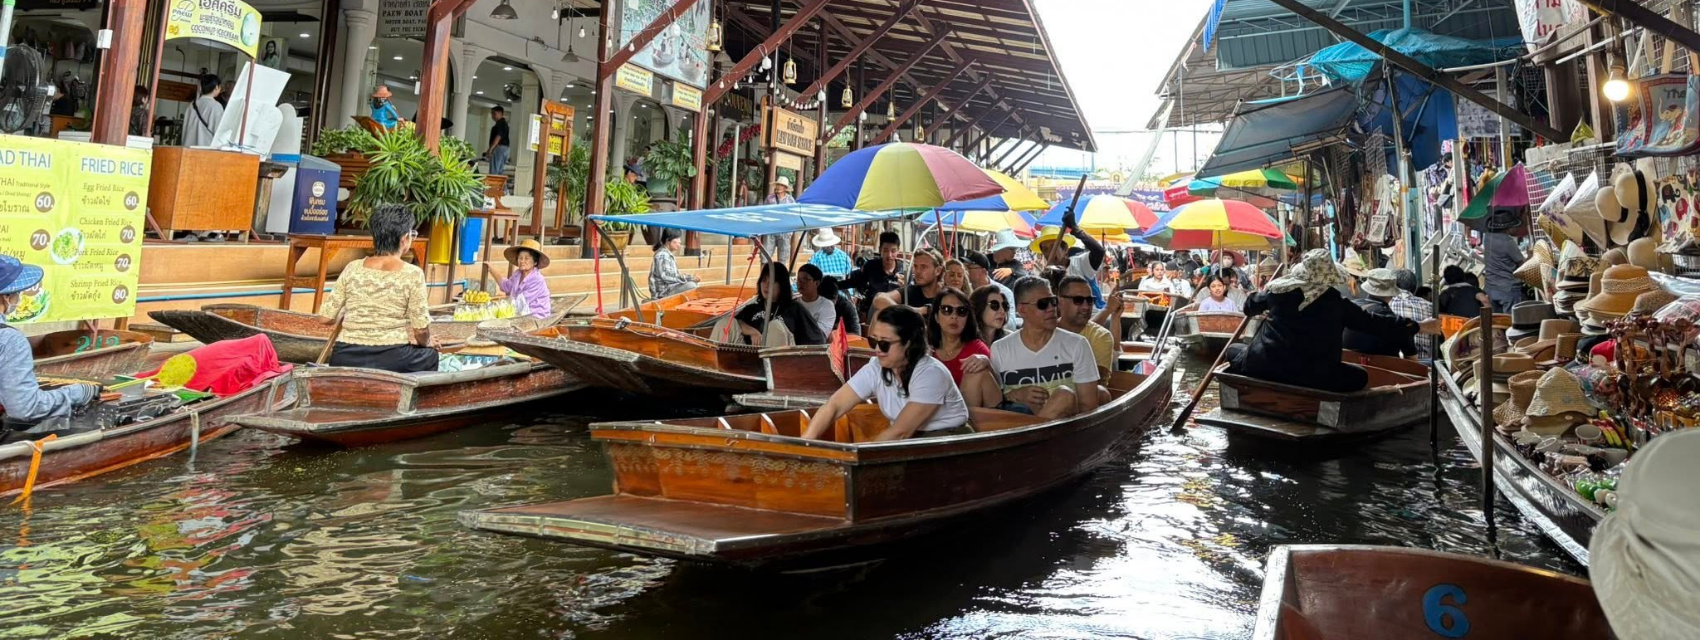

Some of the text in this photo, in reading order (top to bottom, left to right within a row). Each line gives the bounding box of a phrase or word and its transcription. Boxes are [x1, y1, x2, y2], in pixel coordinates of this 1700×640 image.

[191, 24, 216, 35] COCONUT
[19, 150, 51, 168] THAI
[81, 157, 144, 176] FRIED RICE
[83, 182, 125, 192] Egg Fried Rice
[79, 216, 103, 226] Chicken
[104, 217, 120, 226] Fried
[89, 248, 106, 256] Fried
[106, 248, 119, 256] Rice
[70, 279, 92, 289] Shrimp
[94, 279, 109, 287] Fried
[1421, 583, 1471, 638] 6
